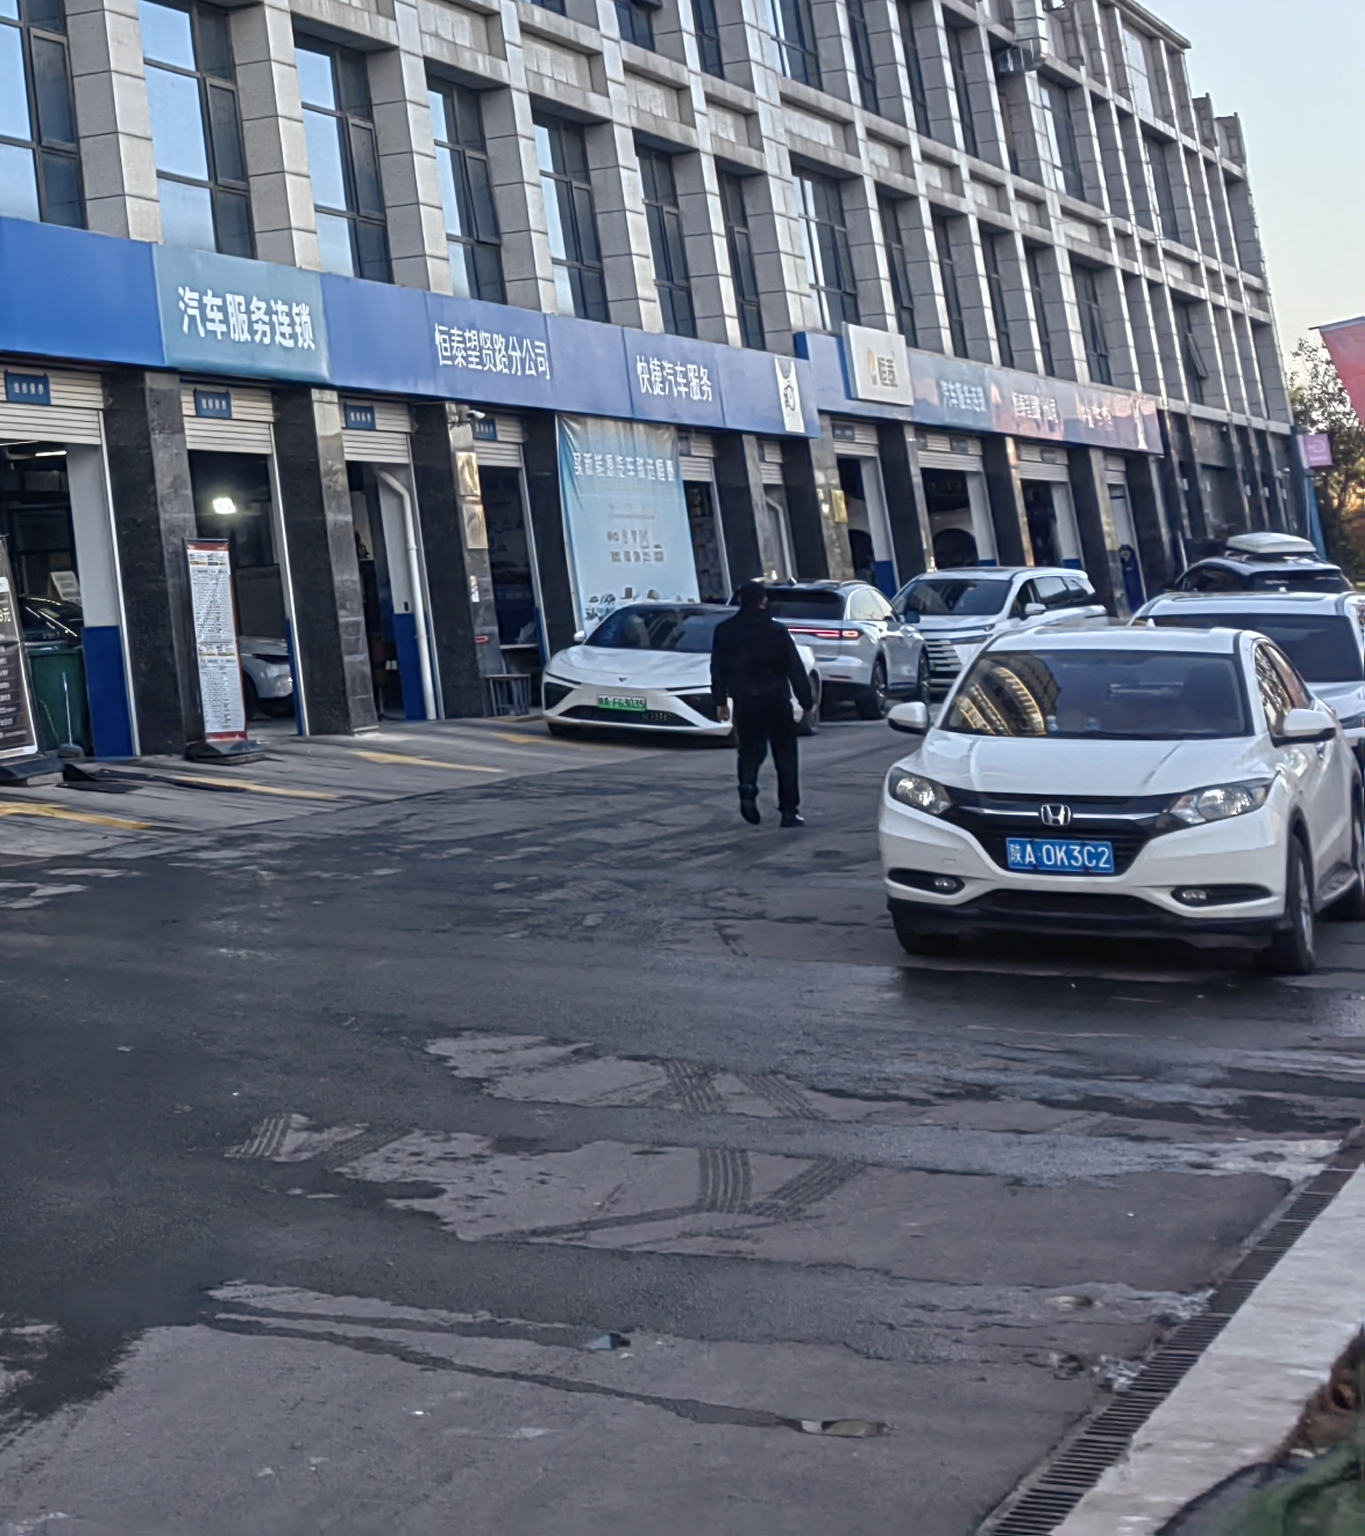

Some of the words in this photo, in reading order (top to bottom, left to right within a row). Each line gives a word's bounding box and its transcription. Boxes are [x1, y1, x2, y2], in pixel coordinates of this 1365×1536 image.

[178, 286, 315, 351] 汽车服务连锁
[435, 322, 550, 381] 恒泰望贤路分公司
[636, 354, 713, 402] 快捷汽车服务
[1009, 843, 1111, 868] 陕A·0K3C2
